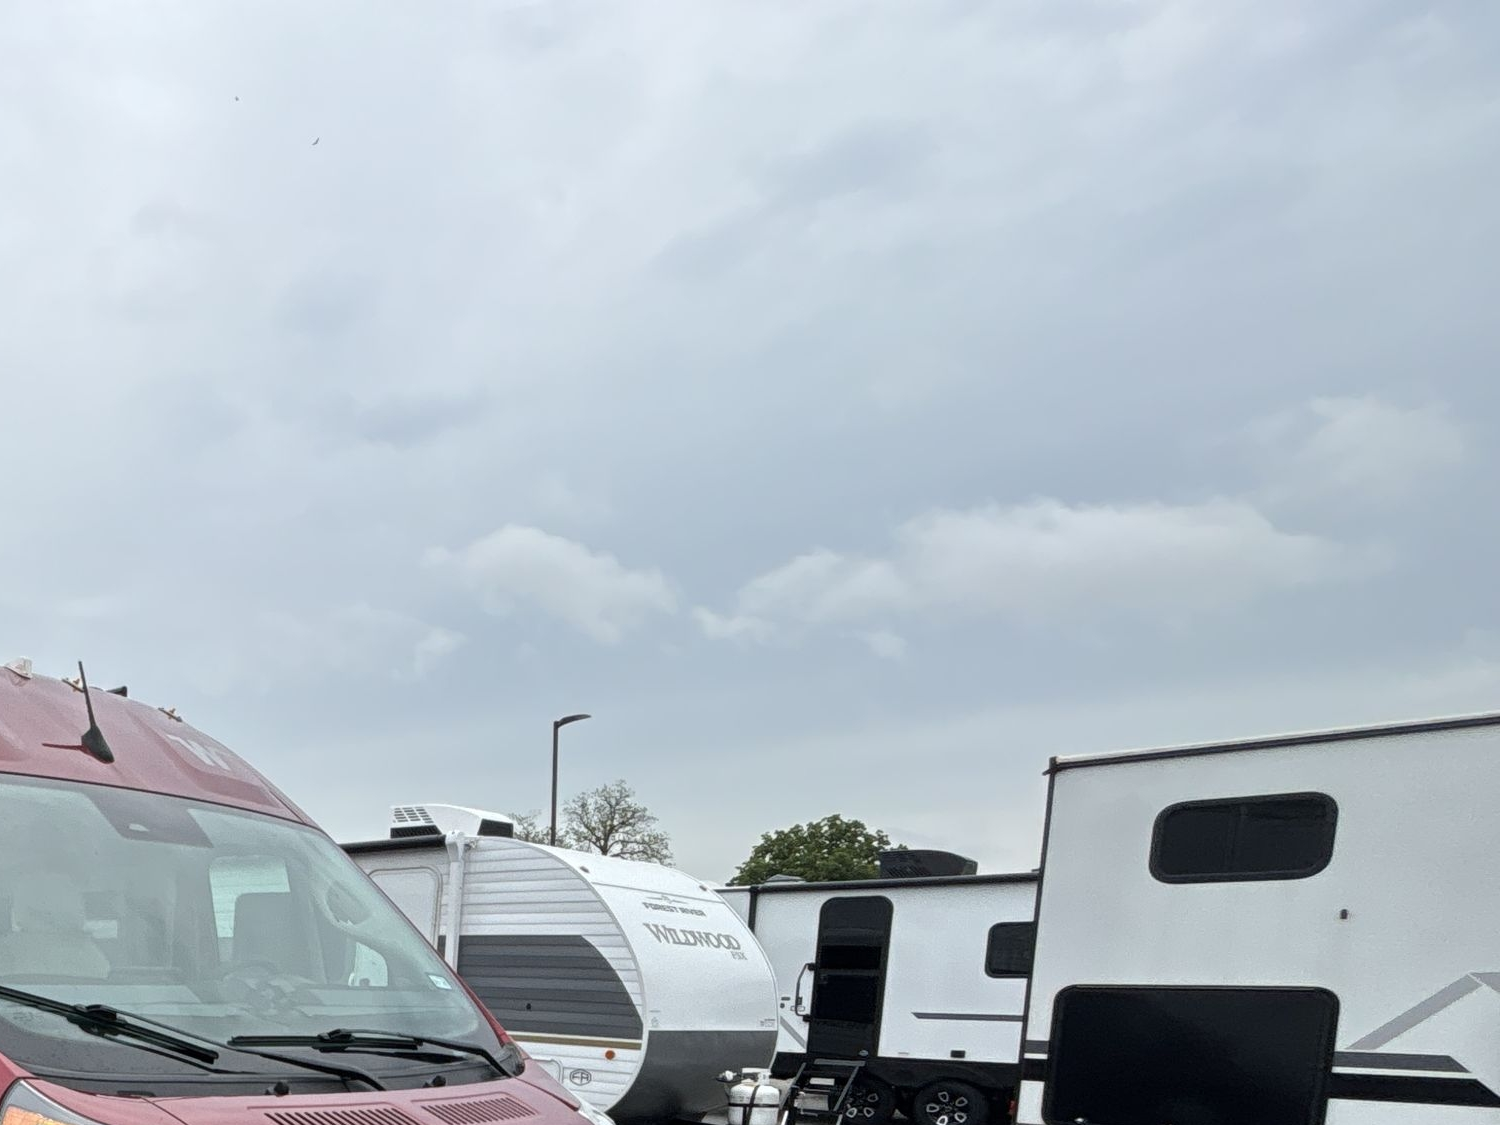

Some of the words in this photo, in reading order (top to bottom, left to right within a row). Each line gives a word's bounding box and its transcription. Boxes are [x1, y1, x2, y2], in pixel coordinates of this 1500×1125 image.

[642, 902, 679, 913] FOREST
[679, 907, 706, 917] RIVER
[643, 923, 741, 950] WILDWOOD
